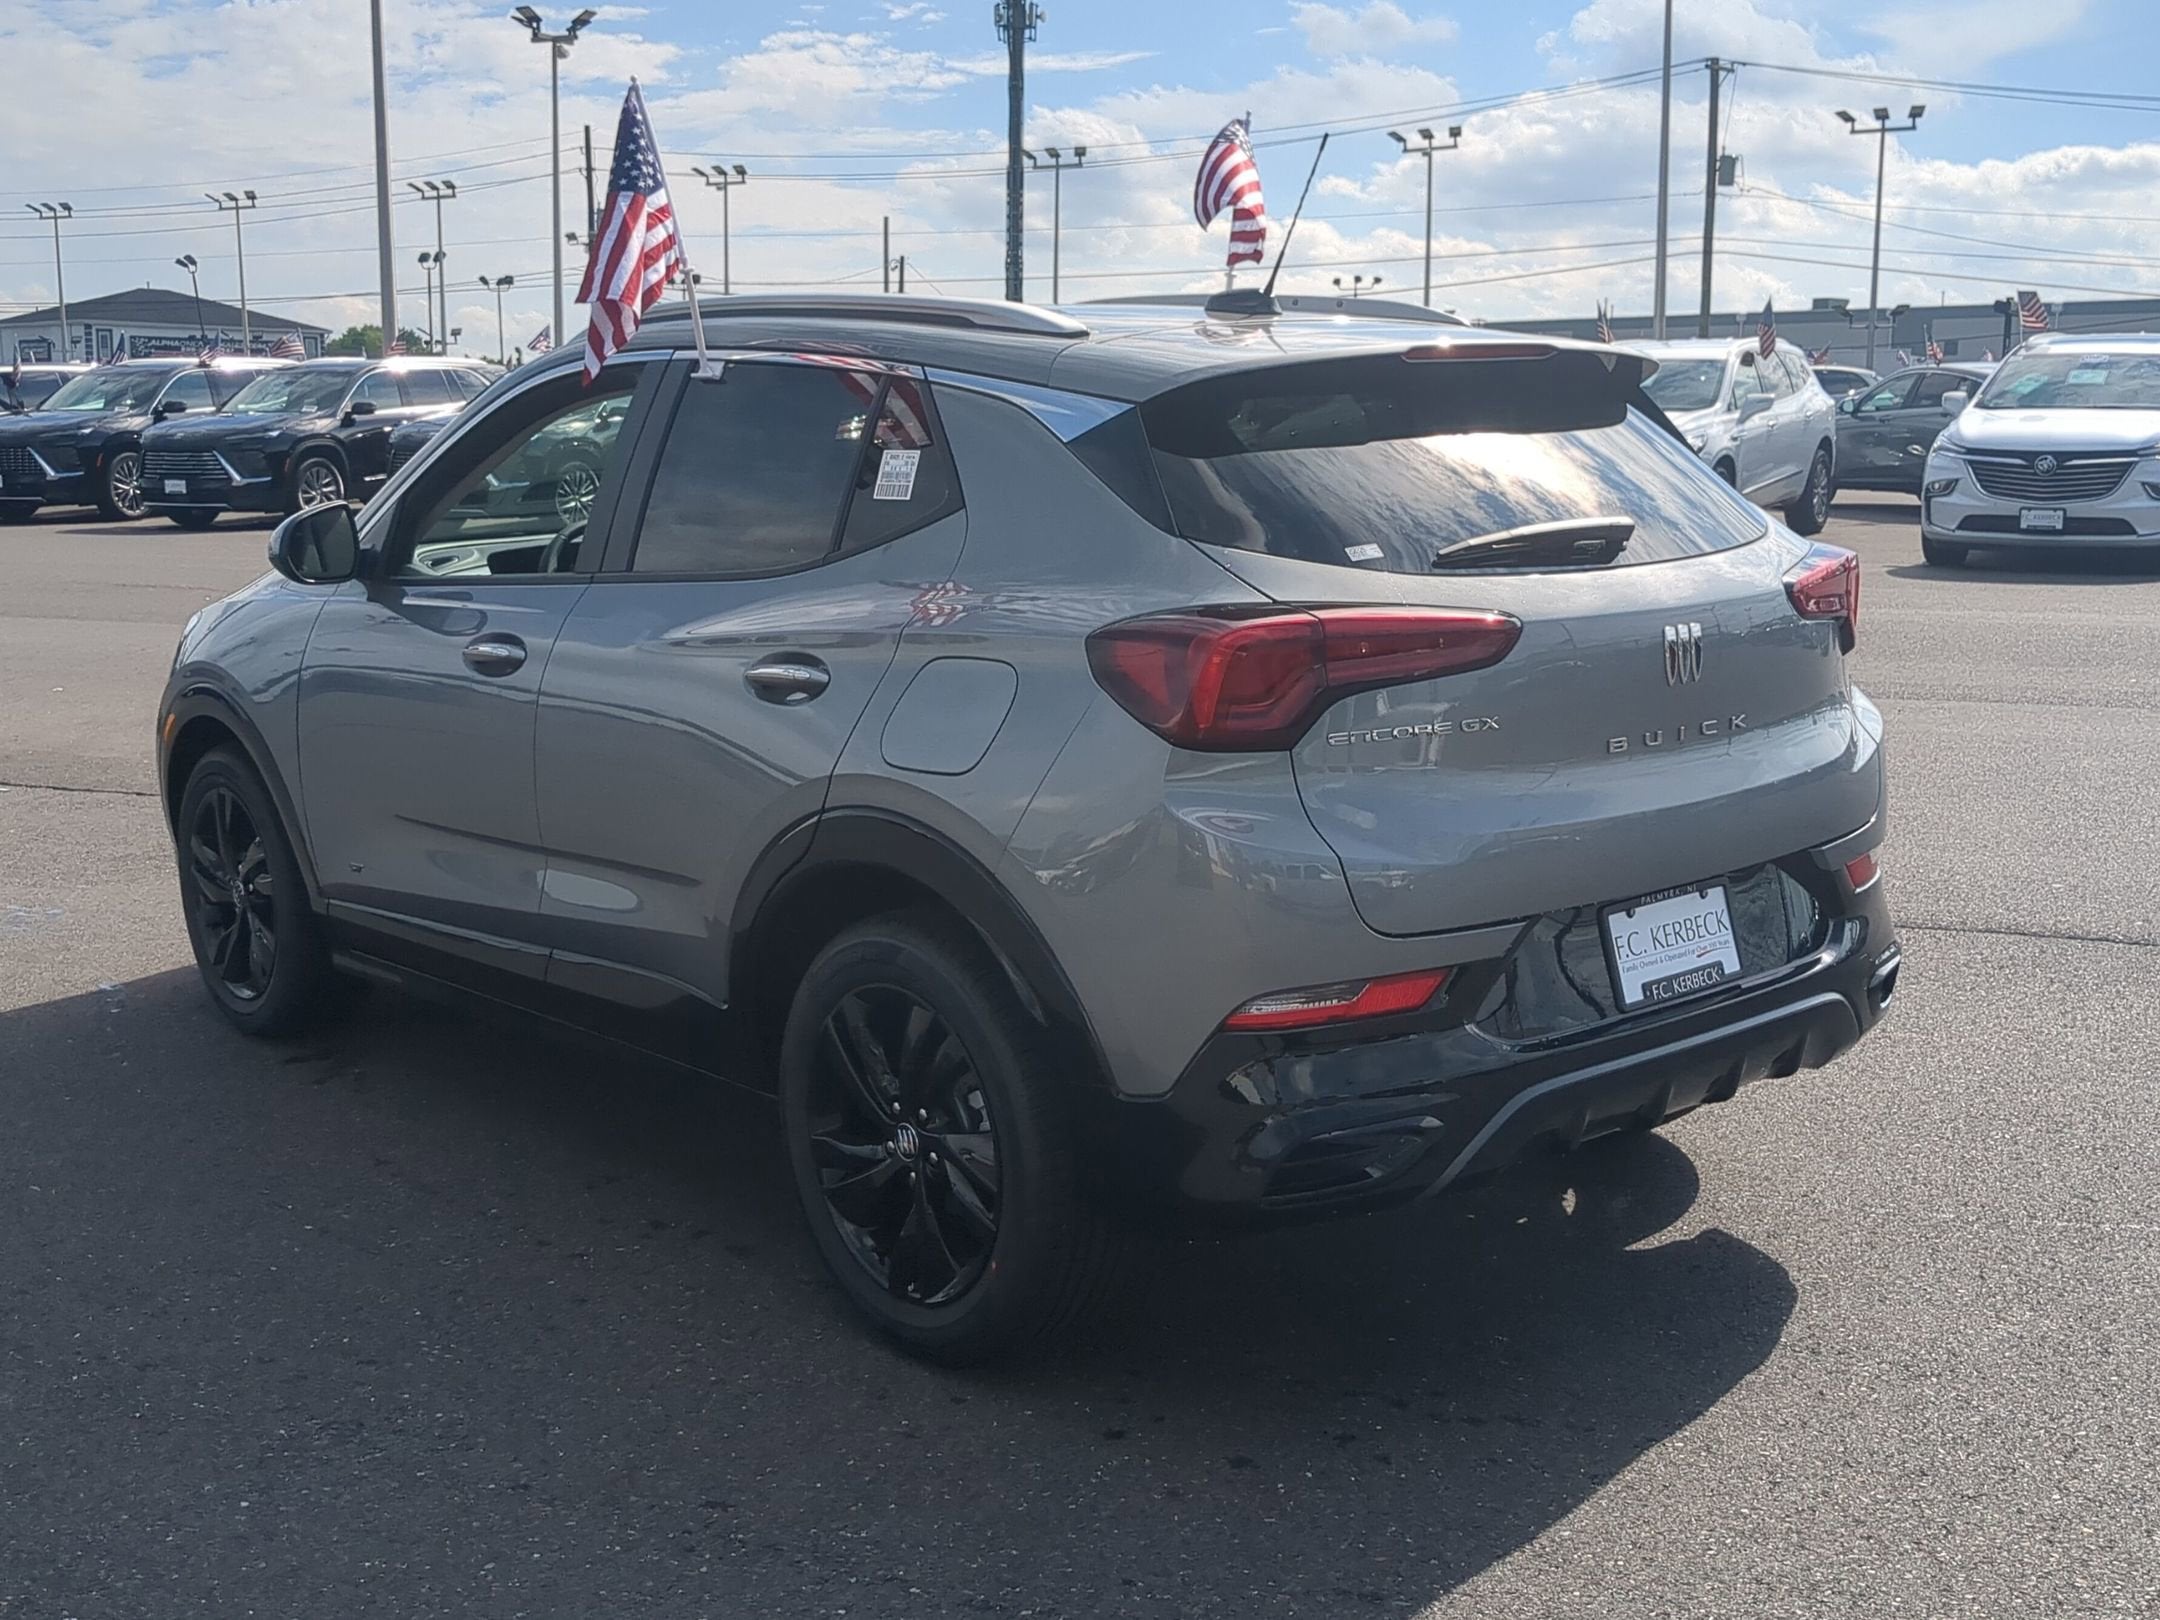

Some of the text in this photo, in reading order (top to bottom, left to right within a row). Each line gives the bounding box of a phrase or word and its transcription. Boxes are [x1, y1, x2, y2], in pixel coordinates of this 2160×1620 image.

[1327, 716, 1500, 746] ENCORE GX
[1608, 713, 1747, 753] BUICK
[1614, 909, 1729, 960] F.C. KERBECK
[1652, 966, 1721, 1001] F.C. KERBECK
